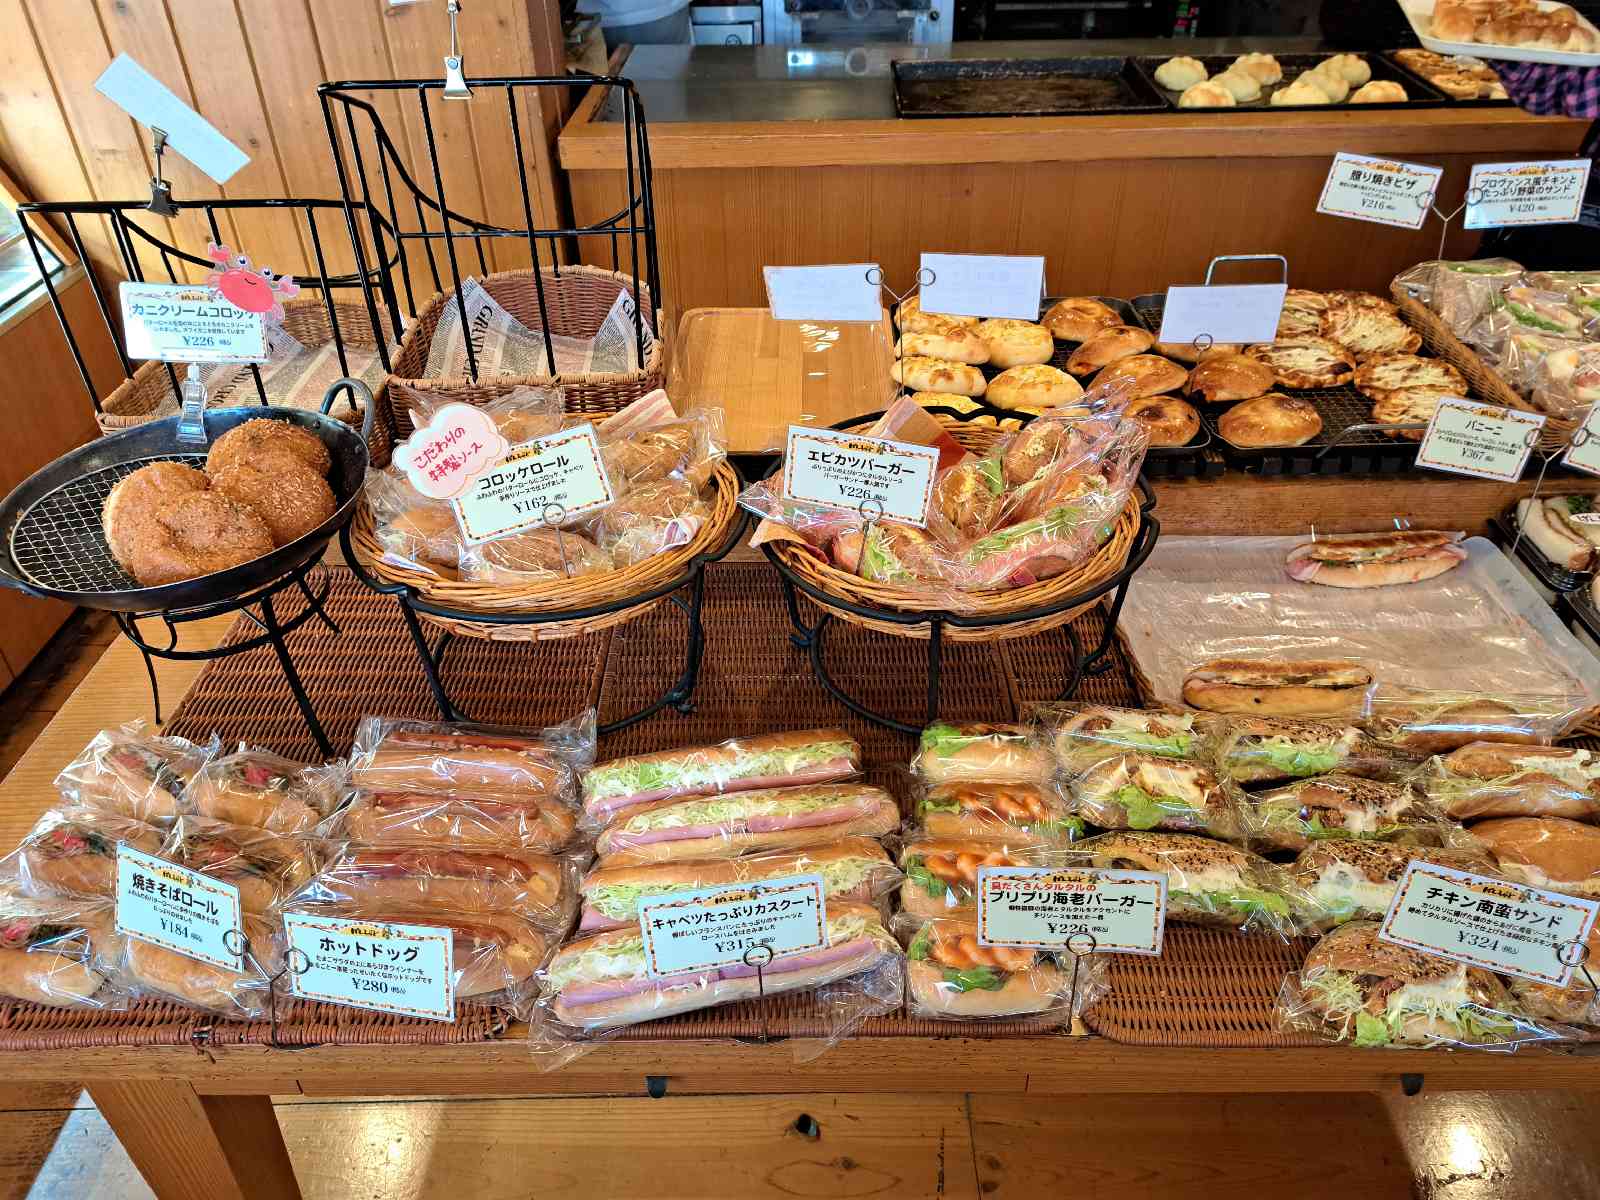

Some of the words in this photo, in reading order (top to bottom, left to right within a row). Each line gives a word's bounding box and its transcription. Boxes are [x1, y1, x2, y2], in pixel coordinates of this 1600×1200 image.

[183, 335, 214, 347] ¥226
[1464, 419, 1503, 436] パニーニ
[413, 427, 466, 469] こだわりの
[428, 441, 483, 482] 特製ソース
[478, 454, 570, 491] コロッケロール
[807, 450, 916, 475] エビカツバーガー
[839, 484, 871, 499] ¥226
[512, 495, 548, 514] ¥162
[132, 872, 218, 916] 焼きそばロール
[652, 896, 816, 930] キャベツたっぷりカスクート
[1426, 886, 1563, 928] チキン南蛮サンド
[160, 918, 189, 939] ¥184
[1047, 922, 1088, 934] ¥226
[319, 937, 420, 962] ホットドッグ
[1456, 930, 1499, 952] ¥324
[352, 977, 388, 994] ¥280
